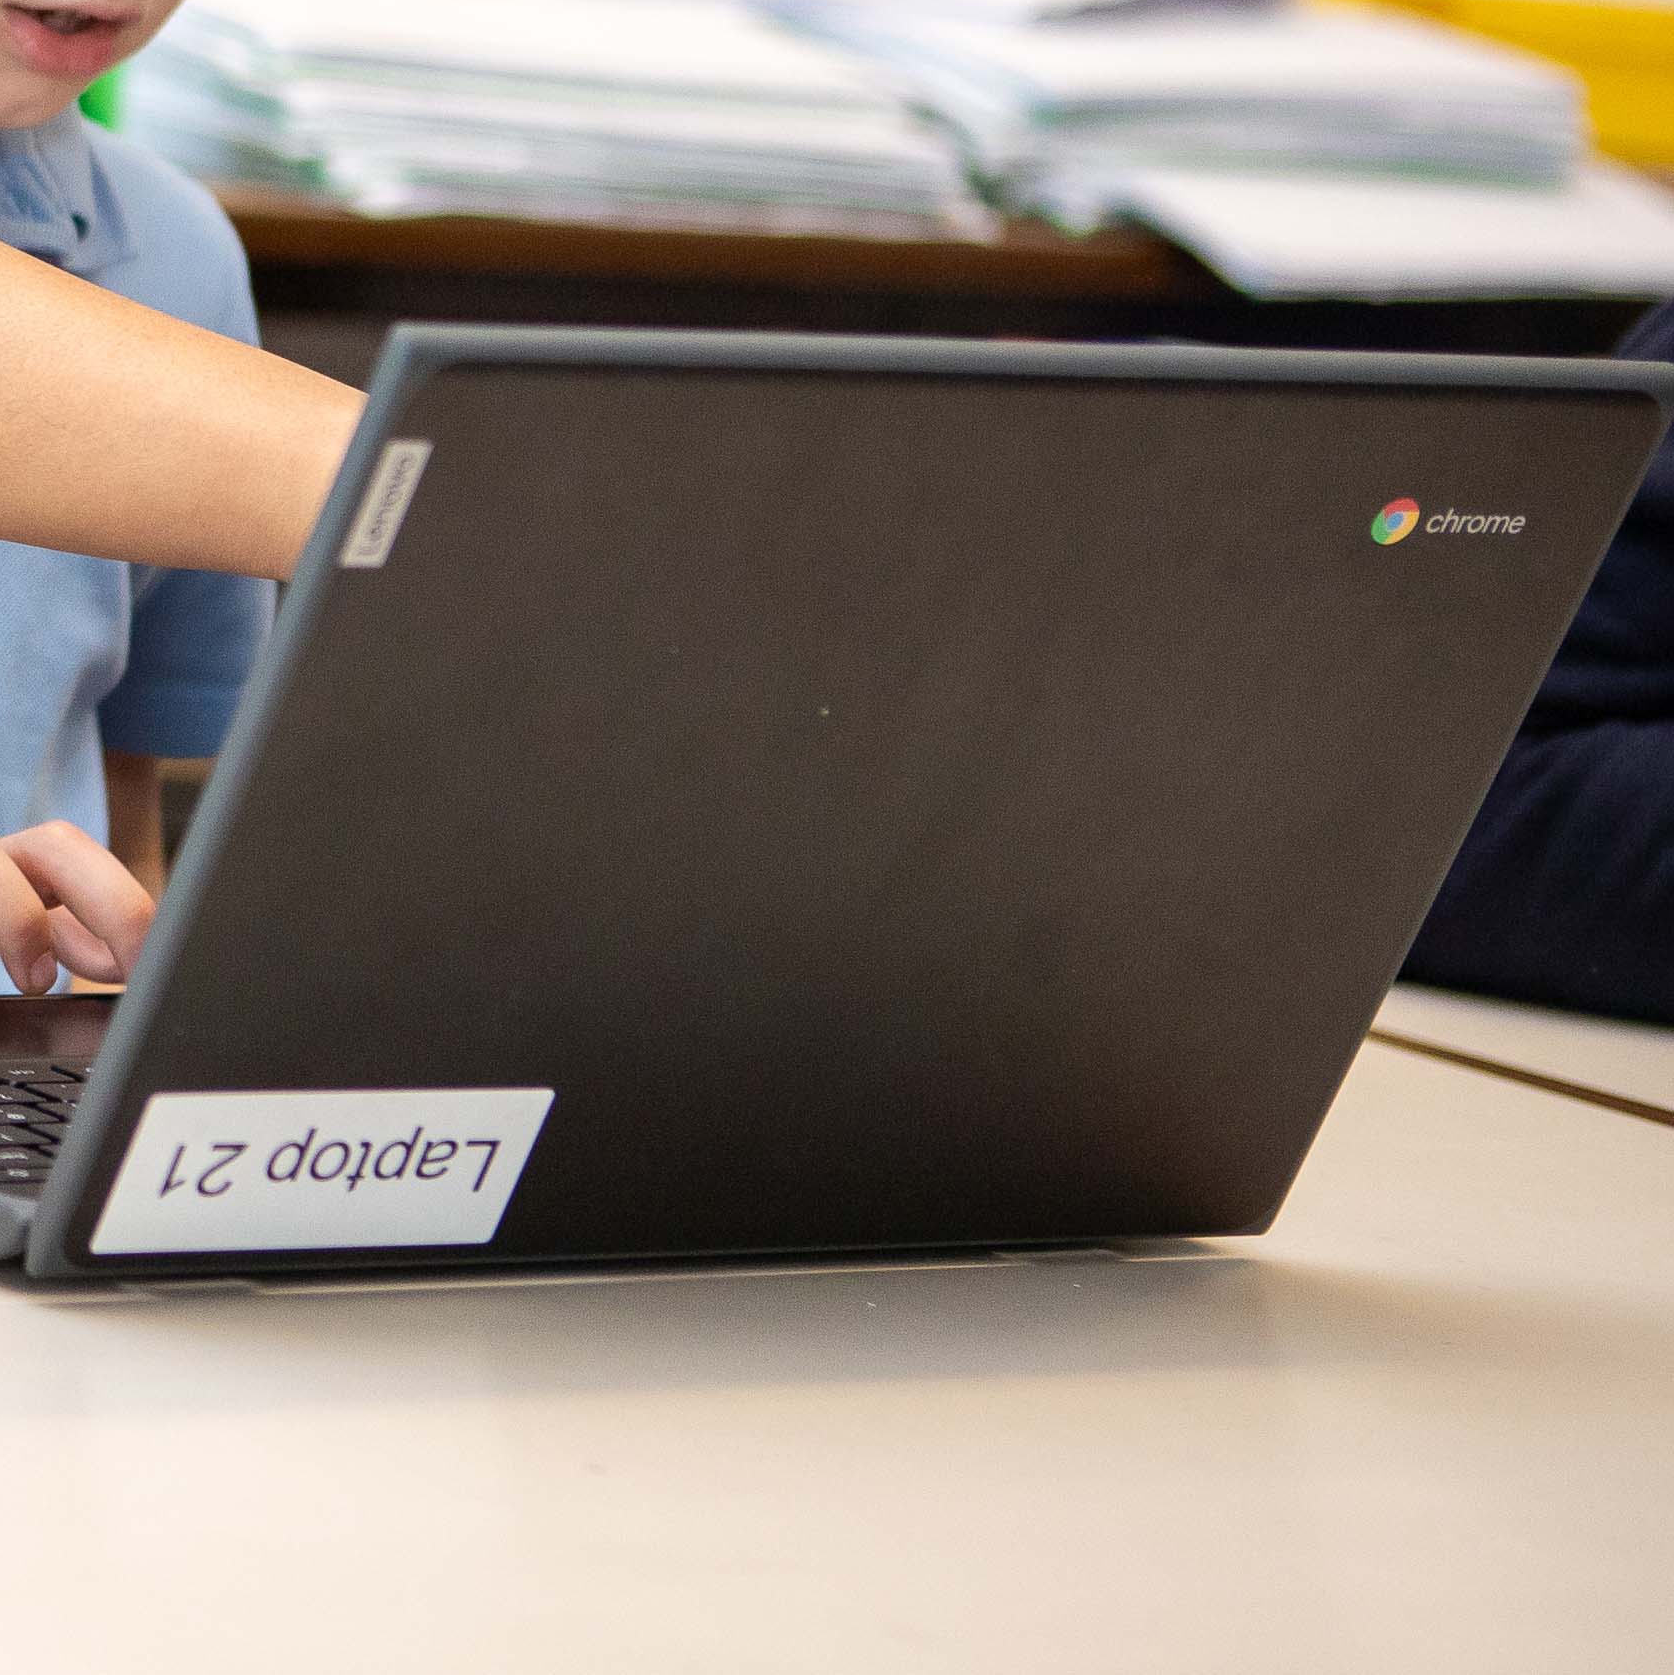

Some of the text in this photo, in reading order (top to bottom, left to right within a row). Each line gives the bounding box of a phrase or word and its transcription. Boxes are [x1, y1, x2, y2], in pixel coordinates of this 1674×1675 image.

[1425, 507, 1526, 534] chrome
[158, 1126, 502, 1198] Laptop 21
